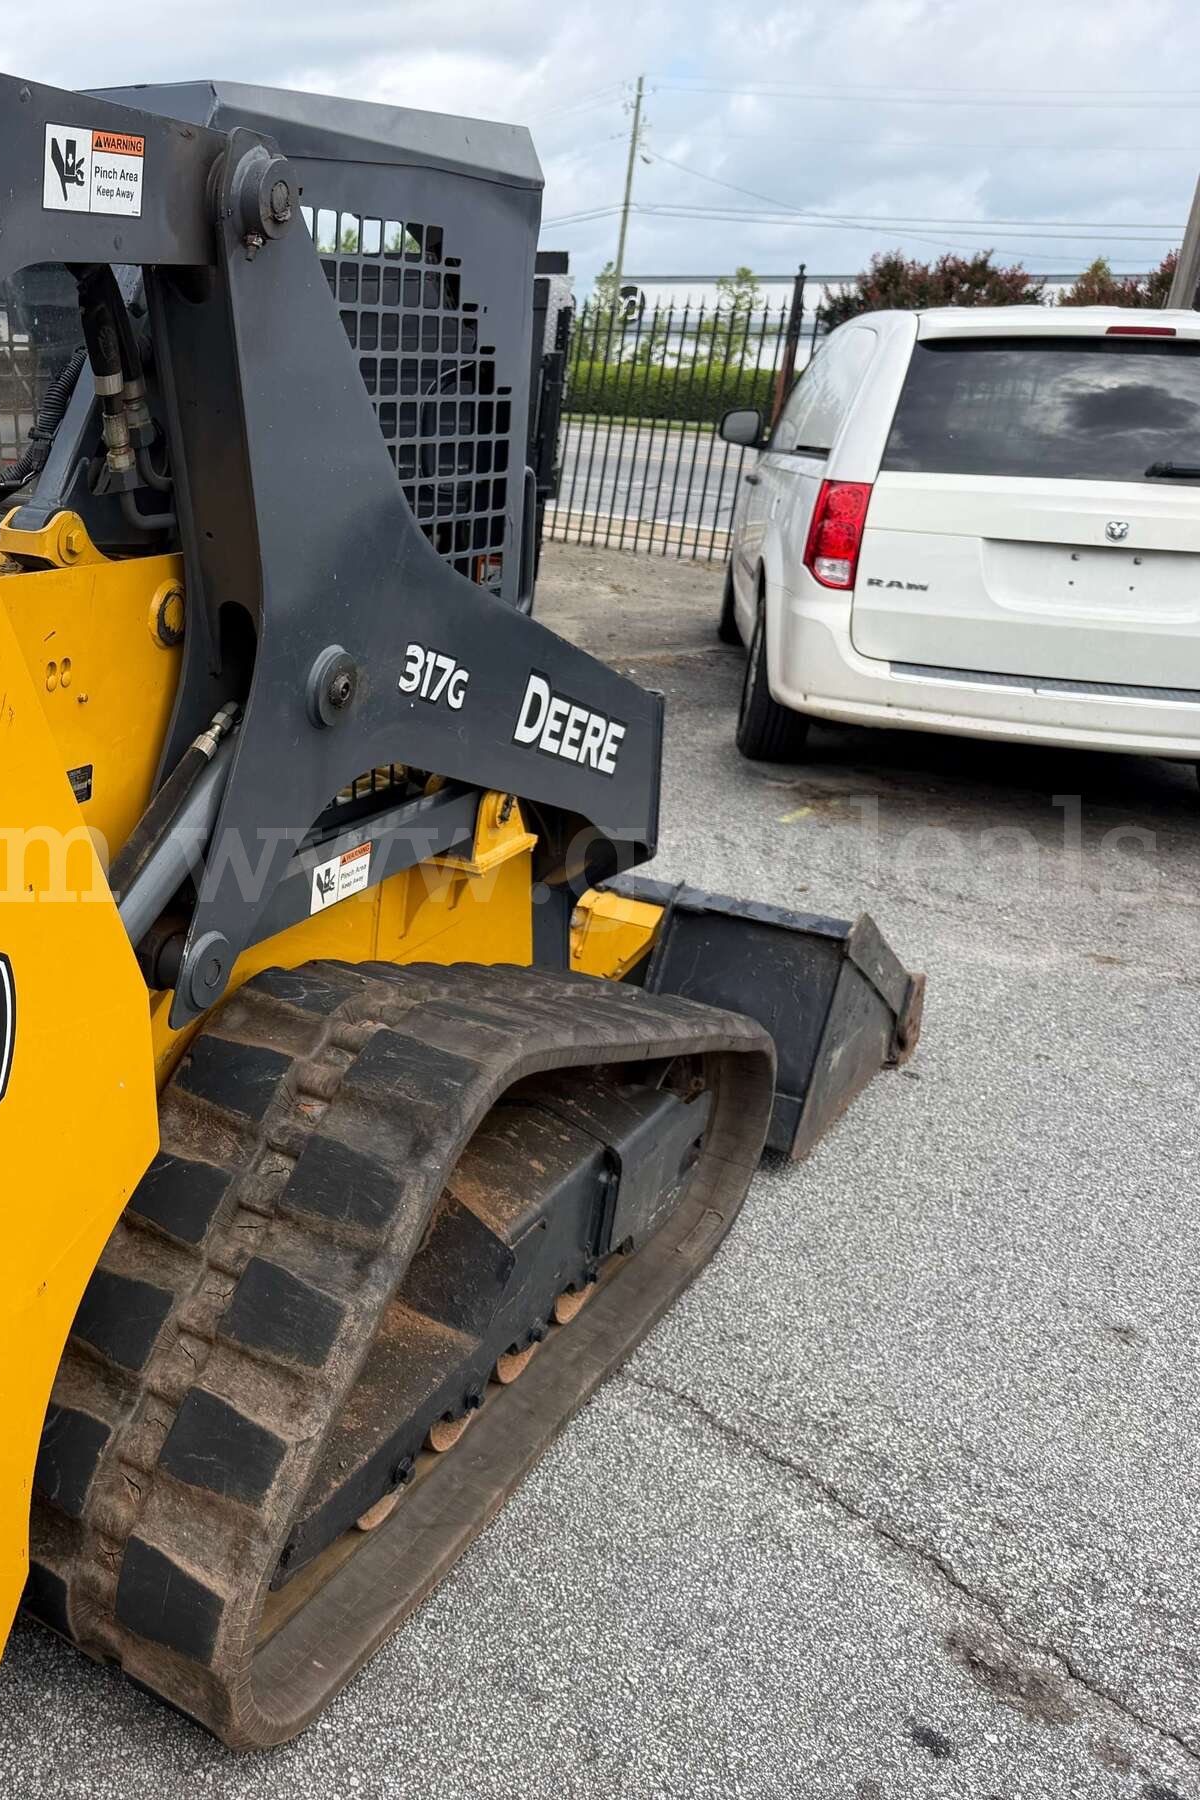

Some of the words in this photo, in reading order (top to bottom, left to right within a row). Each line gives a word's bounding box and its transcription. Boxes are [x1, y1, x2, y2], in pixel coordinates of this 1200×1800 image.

[103, 138, 142, 152] WARNING
[94, 166, 118, 180] Pinch
[119, 170, 138, 182] Area
[96, 185, 115, 200] Keep
[116, 186, 135, 202] Away
[398, 644, 470, 710] 317G
[513, 673, 626, 775] DEERE
